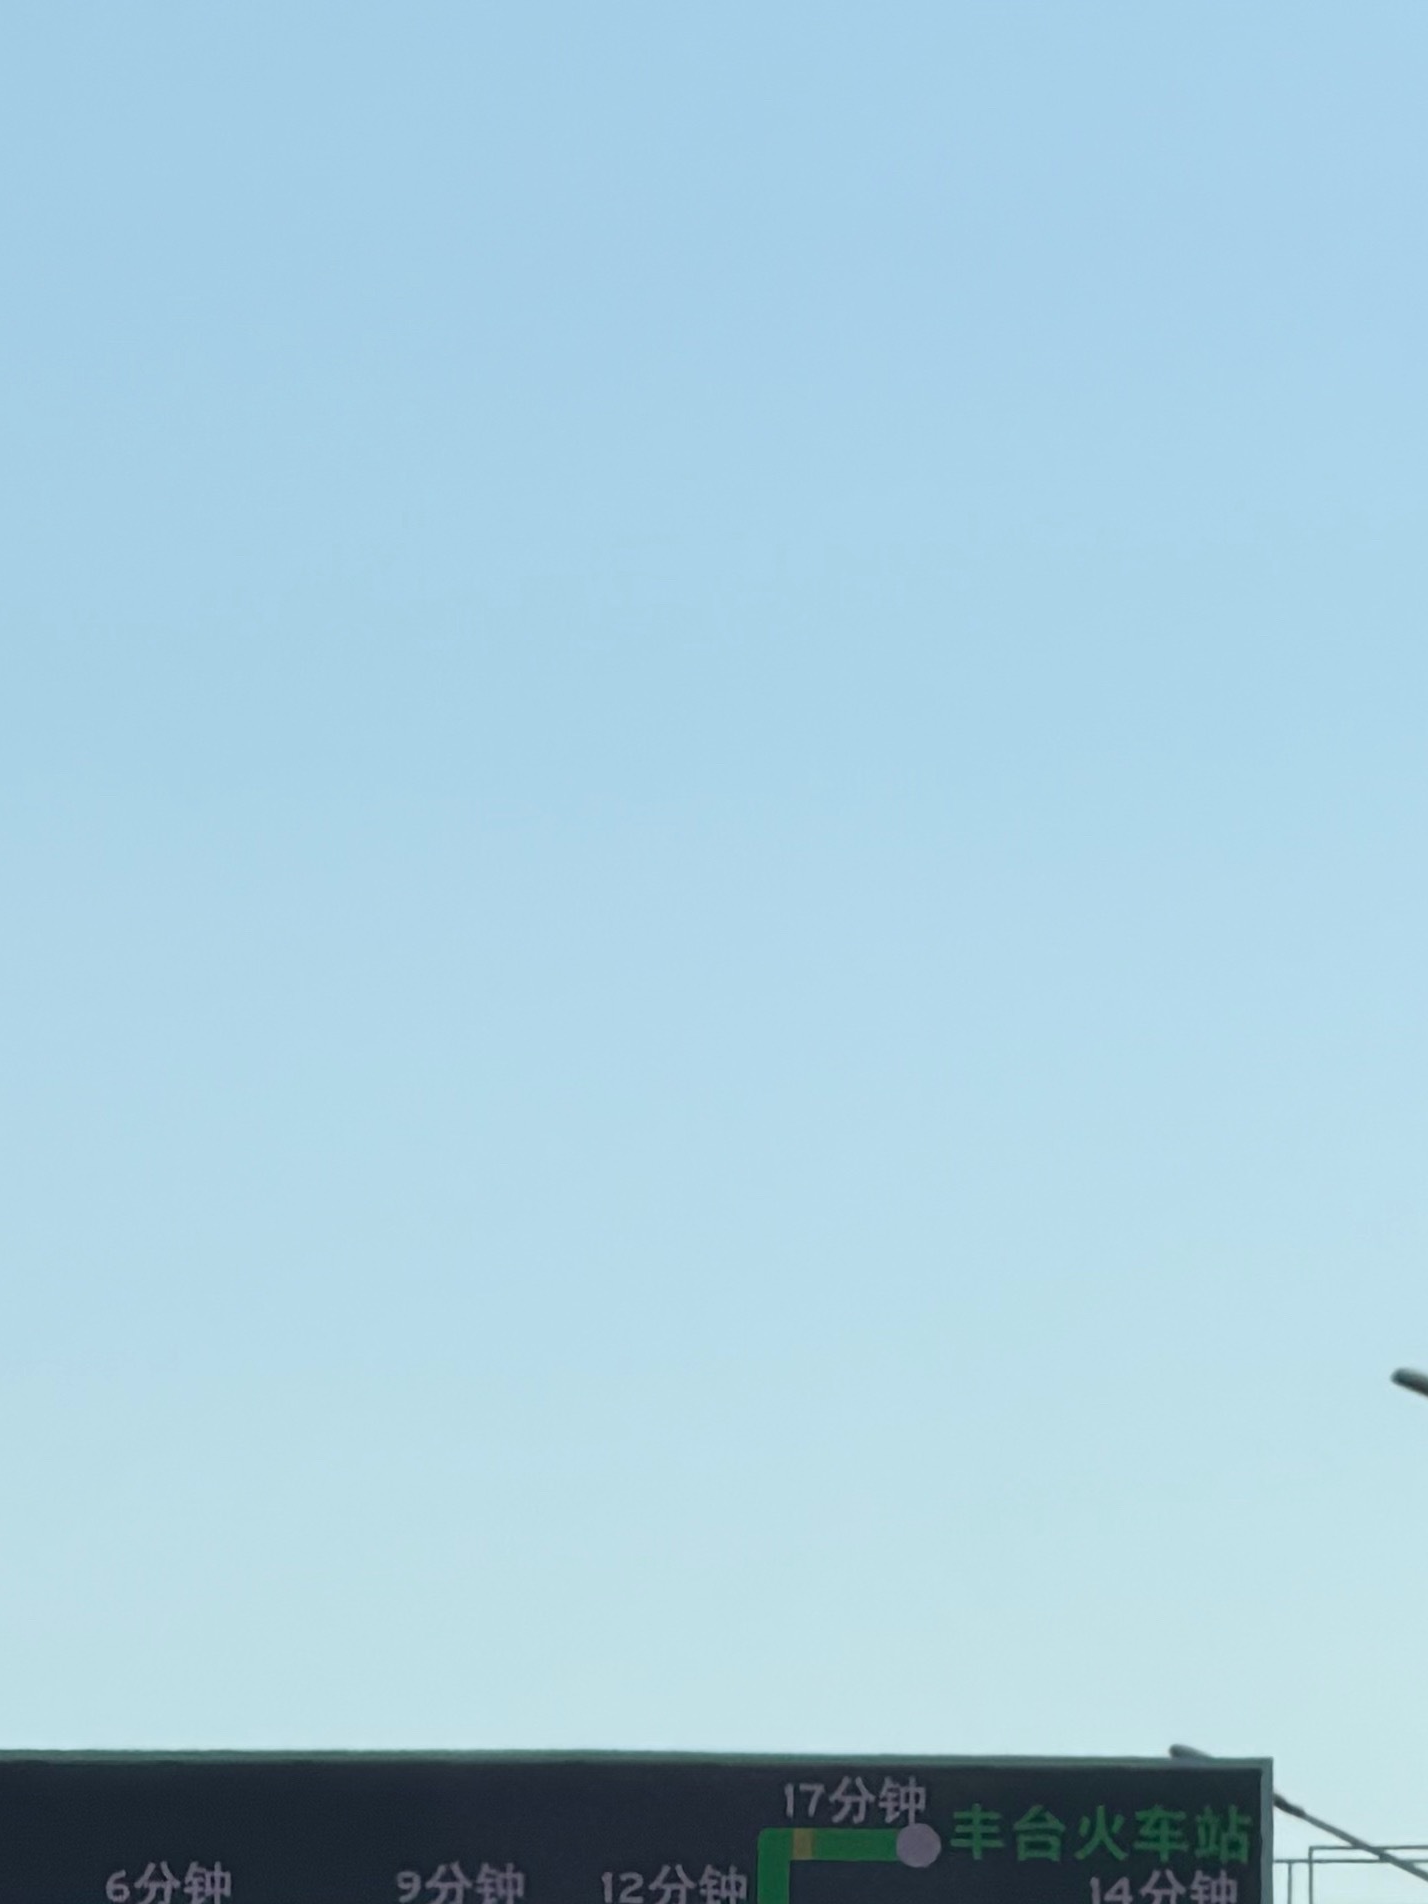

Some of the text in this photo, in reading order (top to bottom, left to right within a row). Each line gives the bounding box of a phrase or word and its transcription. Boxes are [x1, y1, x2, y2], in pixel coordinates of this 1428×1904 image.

[782, 1776, 926, 1826] 17分钟
[950, 1804, 1253, 1863] 丰台火车站
